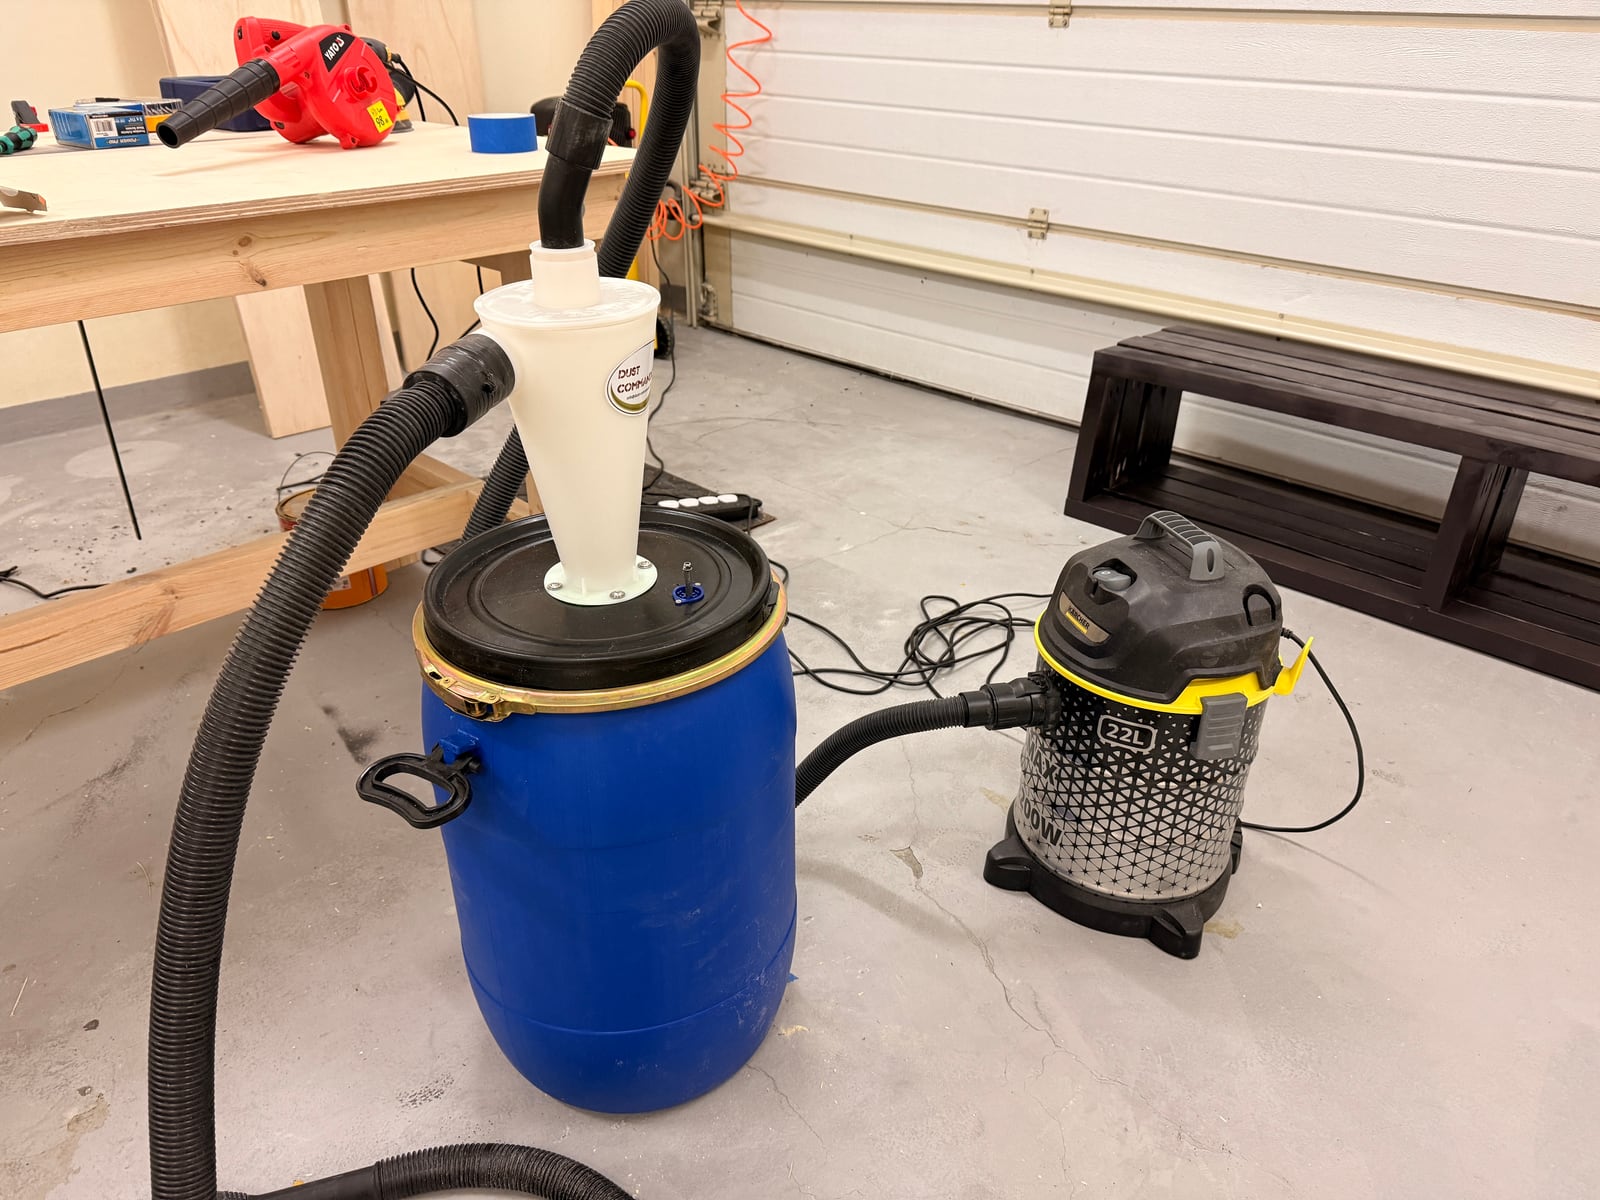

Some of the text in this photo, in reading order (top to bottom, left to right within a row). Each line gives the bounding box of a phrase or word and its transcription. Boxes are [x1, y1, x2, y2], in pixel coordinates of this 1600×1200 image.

[324, 42, 340, 61] YATO
[617, 372, 653, 393] COMMAN
[618, 365, 641, 380] DUST
[1106, 723, 1144, 746] 22L
